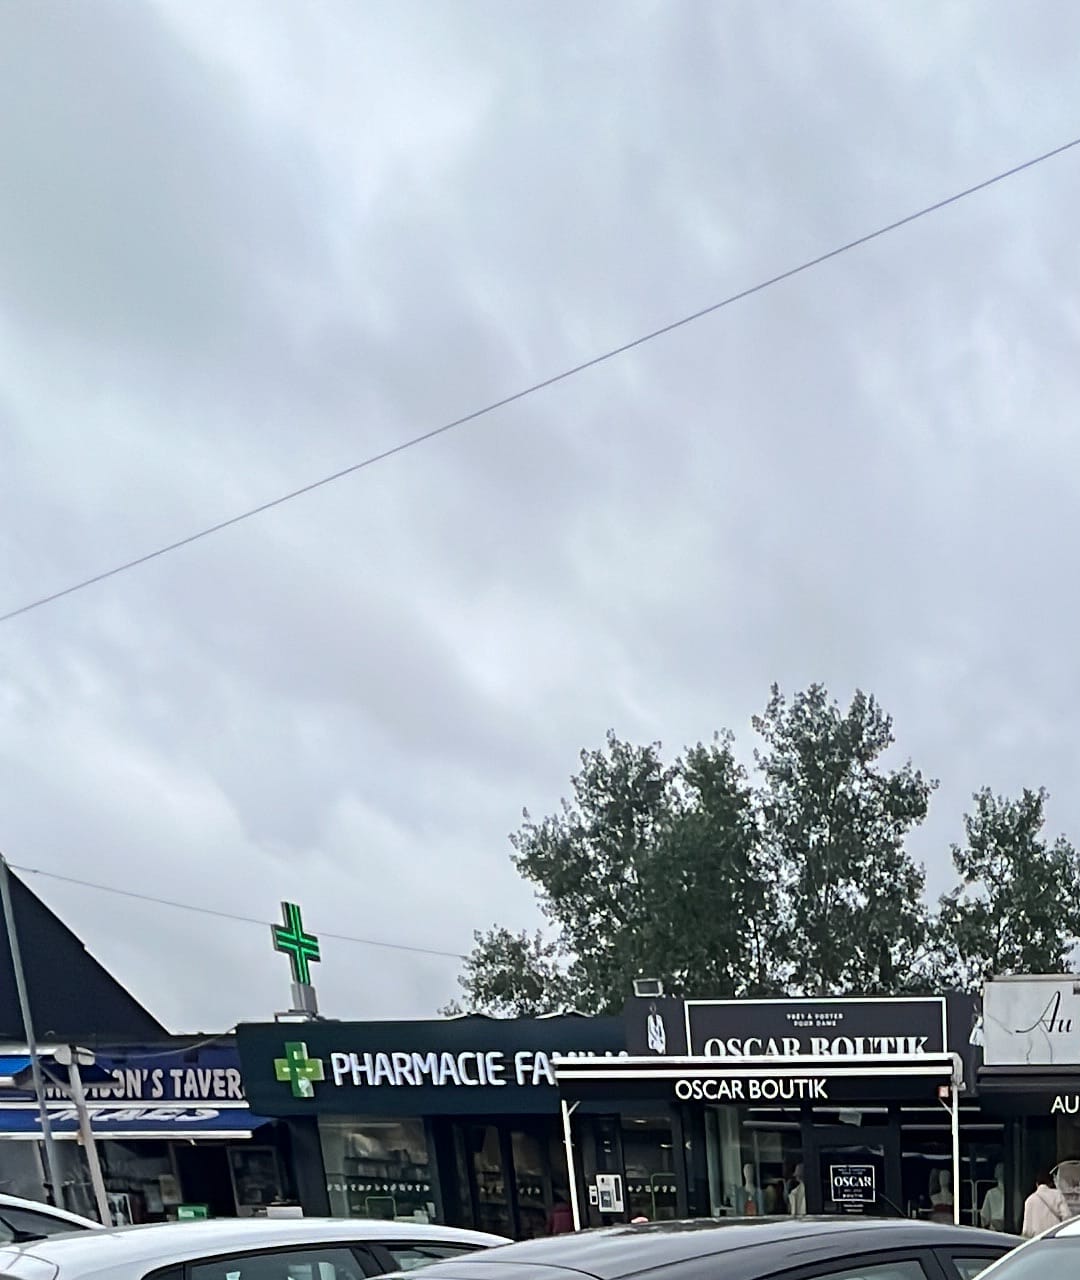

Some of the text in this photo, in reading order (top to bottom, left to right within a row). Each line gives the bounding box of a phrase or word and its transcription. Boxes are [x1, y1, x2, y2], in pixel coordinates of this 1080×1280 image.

[1015, 990, 1072, 1033] Au
[330, 1051, 507, 1086] PHARMACIE
[169, 1068, 246, 1100] TAVER
[674, 1078, 828, 1100] OSCAR BOUTIK
[1051, 1096, 1079, 1113] AU
[834, 1176, 871, 1187] OSCAR
